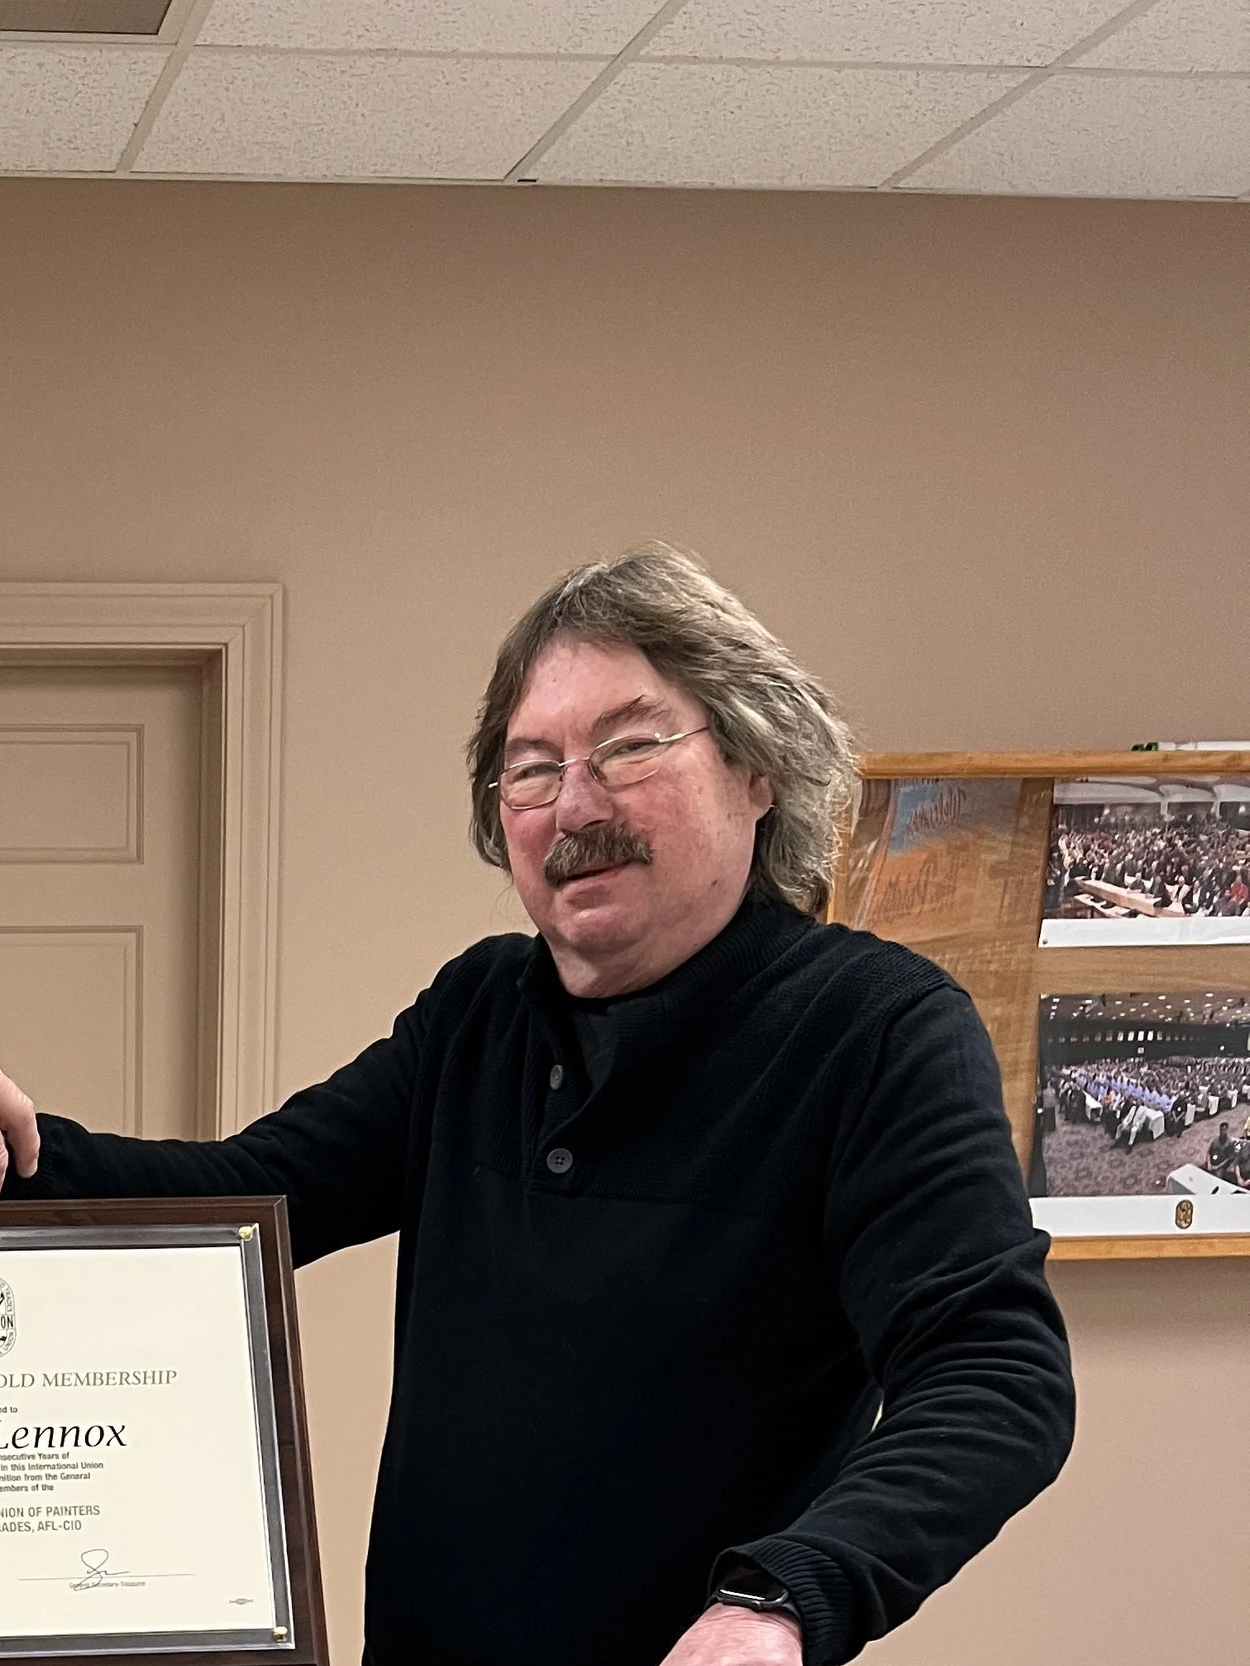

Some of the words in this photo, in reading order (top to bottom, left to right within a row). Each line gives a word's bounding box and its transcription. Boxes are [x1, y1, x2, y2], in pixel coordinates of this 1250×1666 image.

[41, 1370, 178, 1388] MEMBERSHIP
[9, 1405, 18, 1413] to
[38, 1452, 60, 1461] Years
[62, 1452, 70, 1460] of
[10, 1463, 26, 1471] this
[28, 1461, 79, 1470] International
[81, 1461, 104, 1469] Union
[23, 1473, 43, 1481] from
[45, 1472, 58, 1480] the
[60, 1471, 91, 1480] General
[41, 1483, 54, 1491] the
[28, 1506, 43, 1517] OF
[46, 1505, 101, 1517] PAINTERS
[37, 1520, 82, 1532] AFL-CIO
